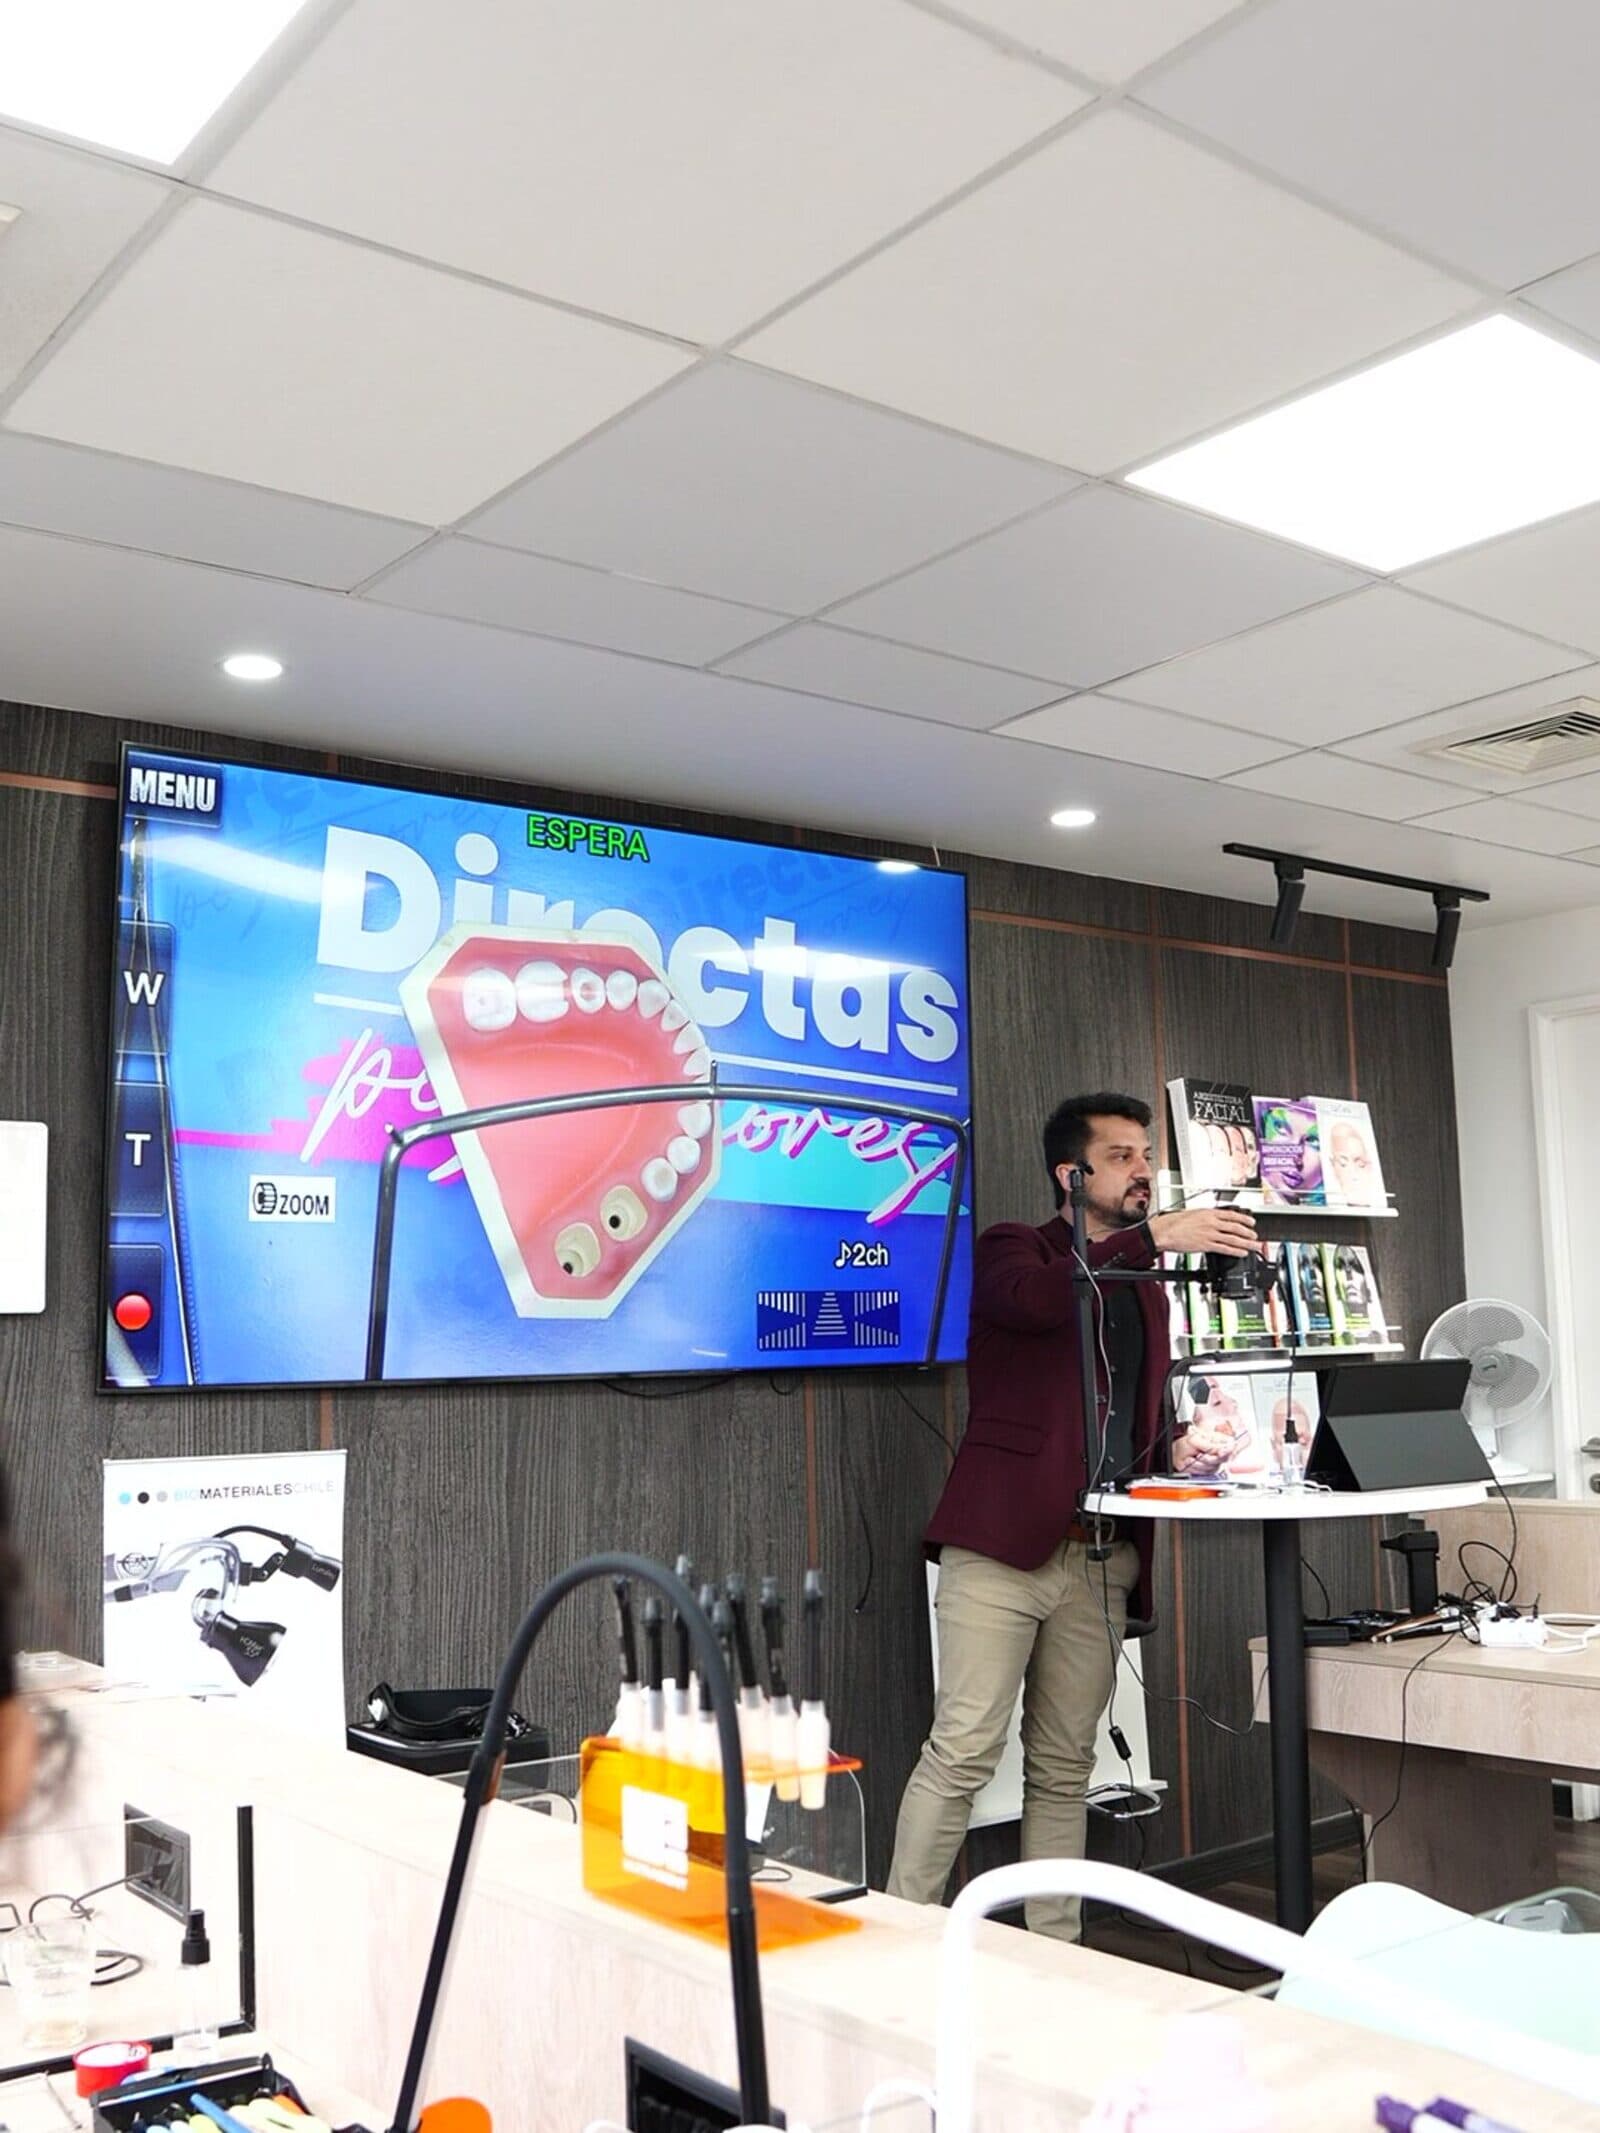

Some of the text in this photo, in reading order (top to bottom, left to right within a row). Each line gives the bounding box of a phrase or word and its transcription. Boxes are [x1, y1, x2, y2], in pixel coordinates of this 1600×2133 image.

[129, 767, 217, 812] MENU
[526, 815, 649, 862] ESPERA
[124, 971, 165, 1006] W
[1193, 1101, 1251, 1123] FACIAL
[124, 1133, 152, 1167] T
[279, 1192, 330, 1218] ZOOM
[852, 1243, 890, 1267] 2ch
